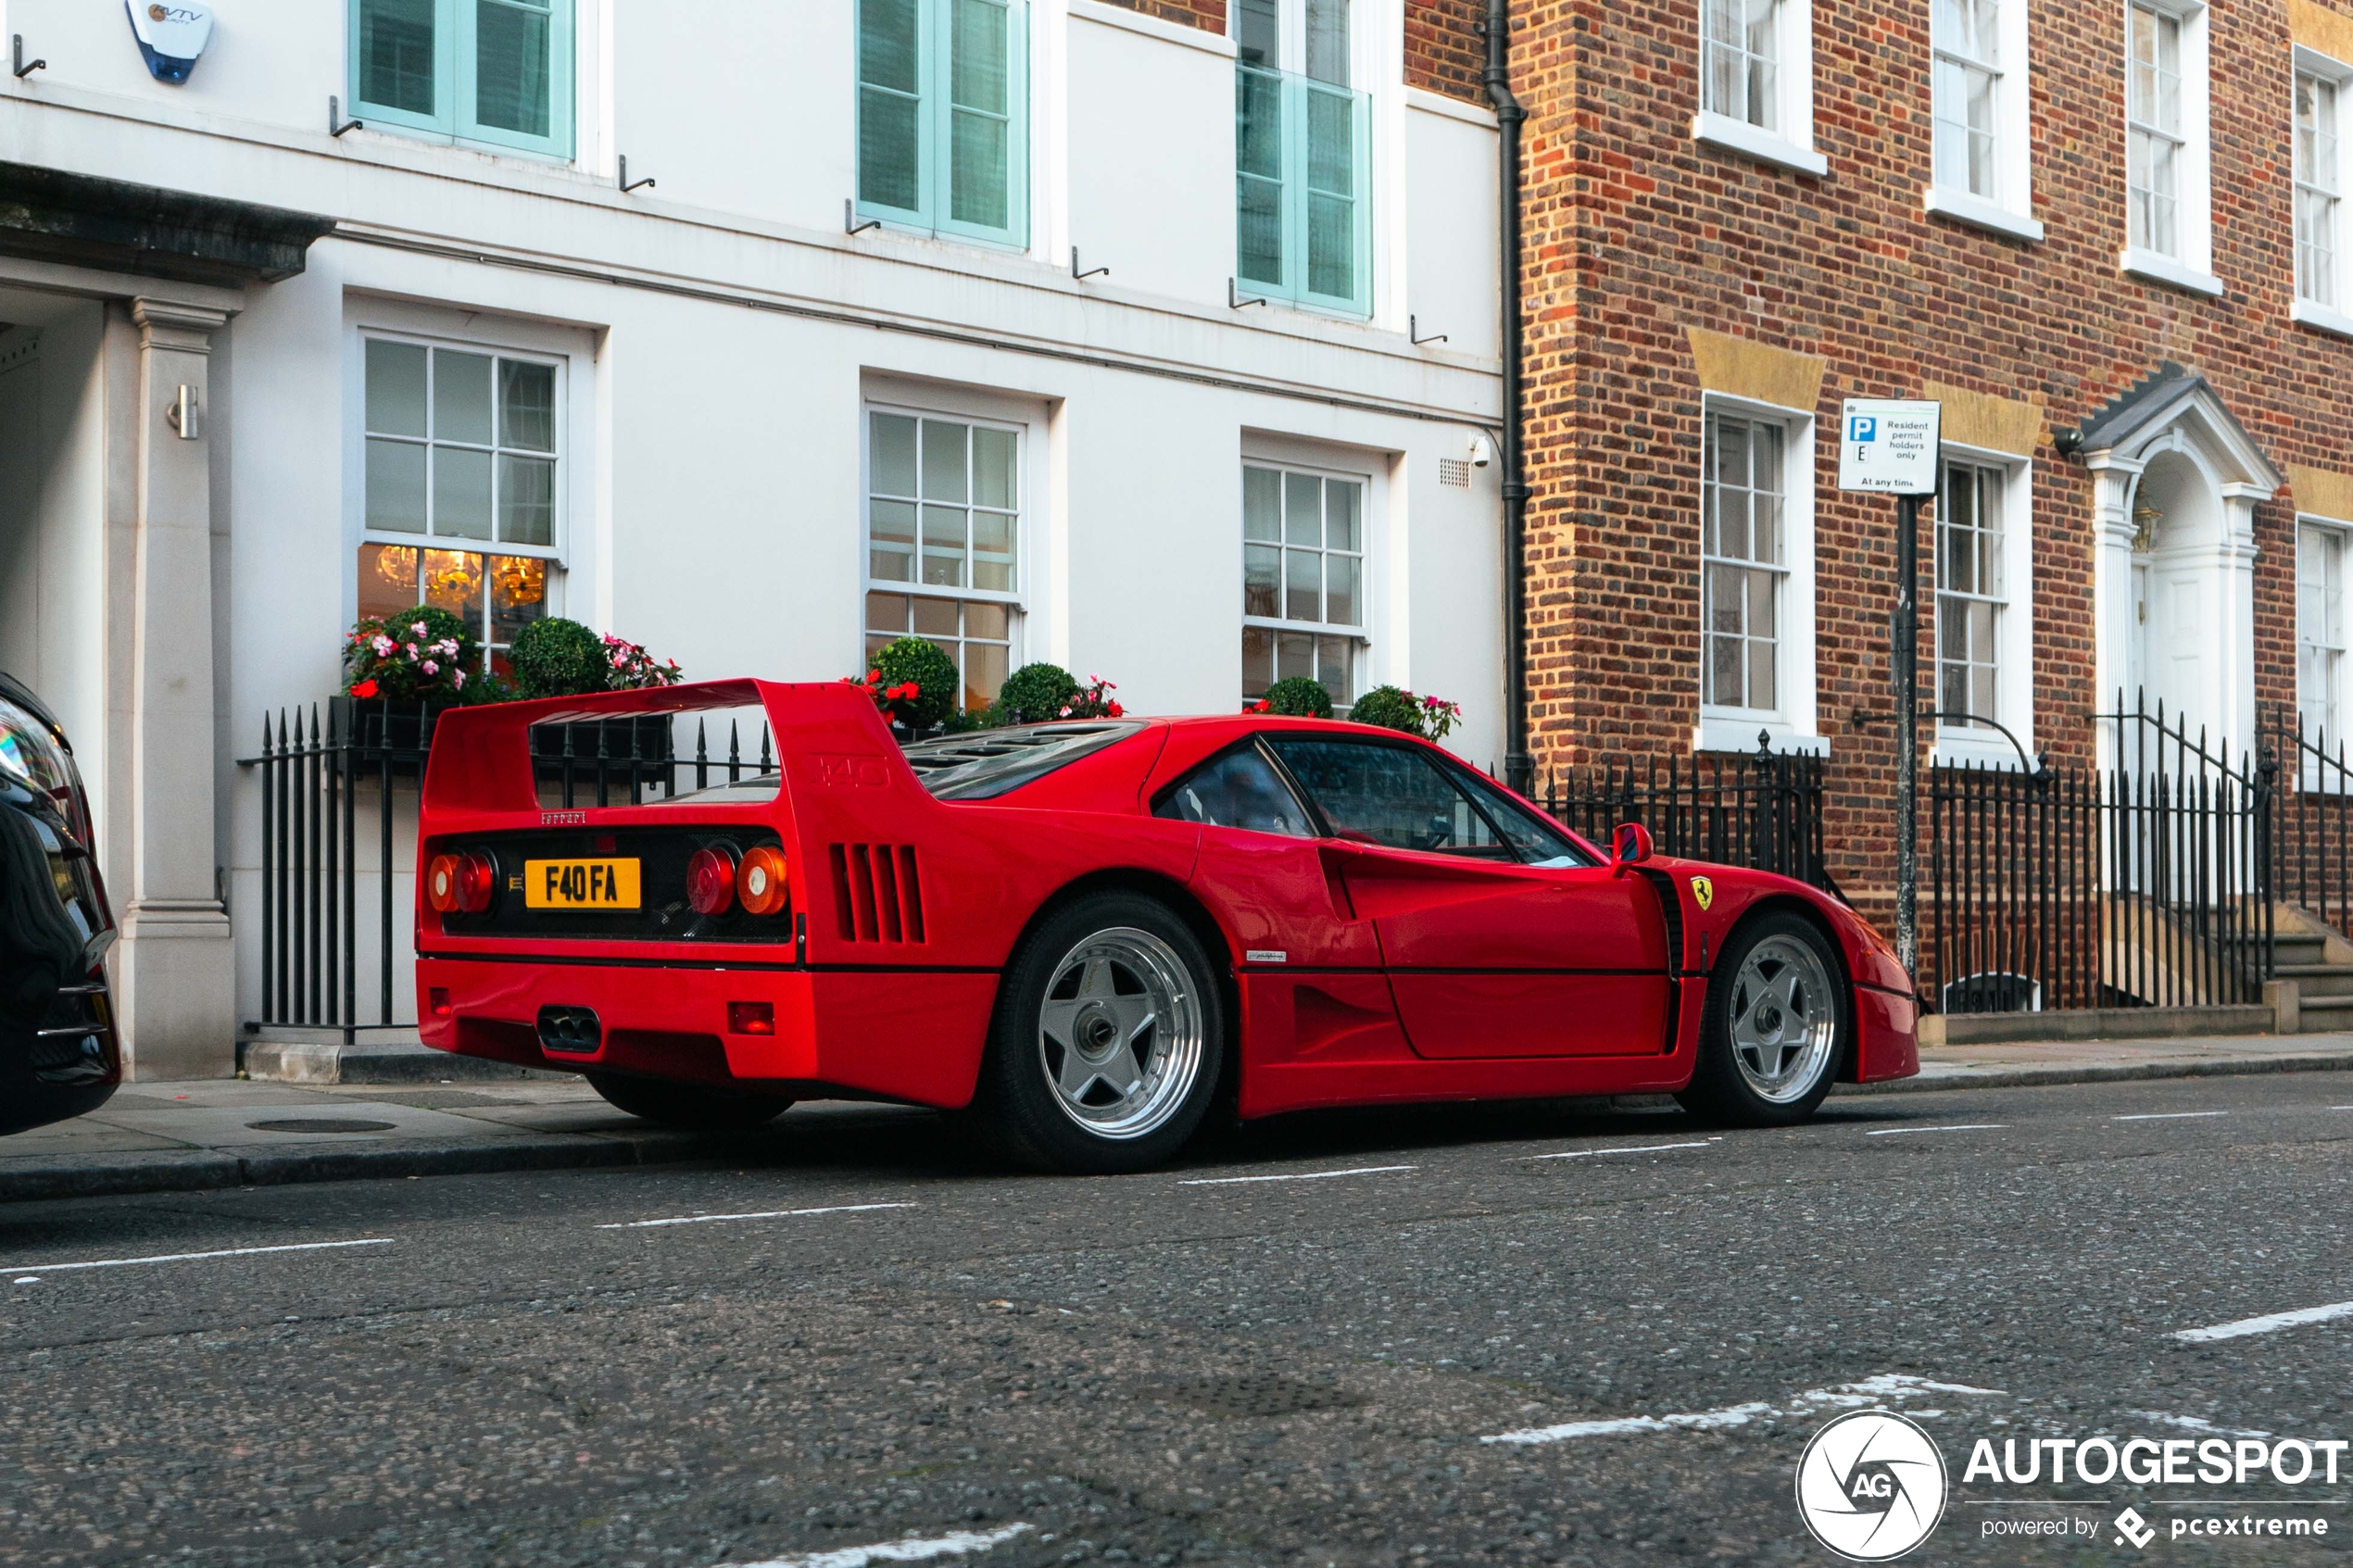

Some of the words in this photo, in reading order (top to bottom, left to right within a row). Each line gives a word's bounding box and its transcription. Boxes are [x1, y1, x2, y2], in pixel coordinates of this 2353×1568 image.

[1854, 418, 1872, 440] P
[1887, 420, 1929, 431] Resident
[1892, 431, 1923, 441] permit
[1889, 441, 1925, 450] holders
[1858, 445, 1866, 461] E
[1896, 452, 1917, 460] only
[541, 811, 585, 825] Ferrari
[546, 865, 586, 902] F40
[590, 864, 618, 901] FA
